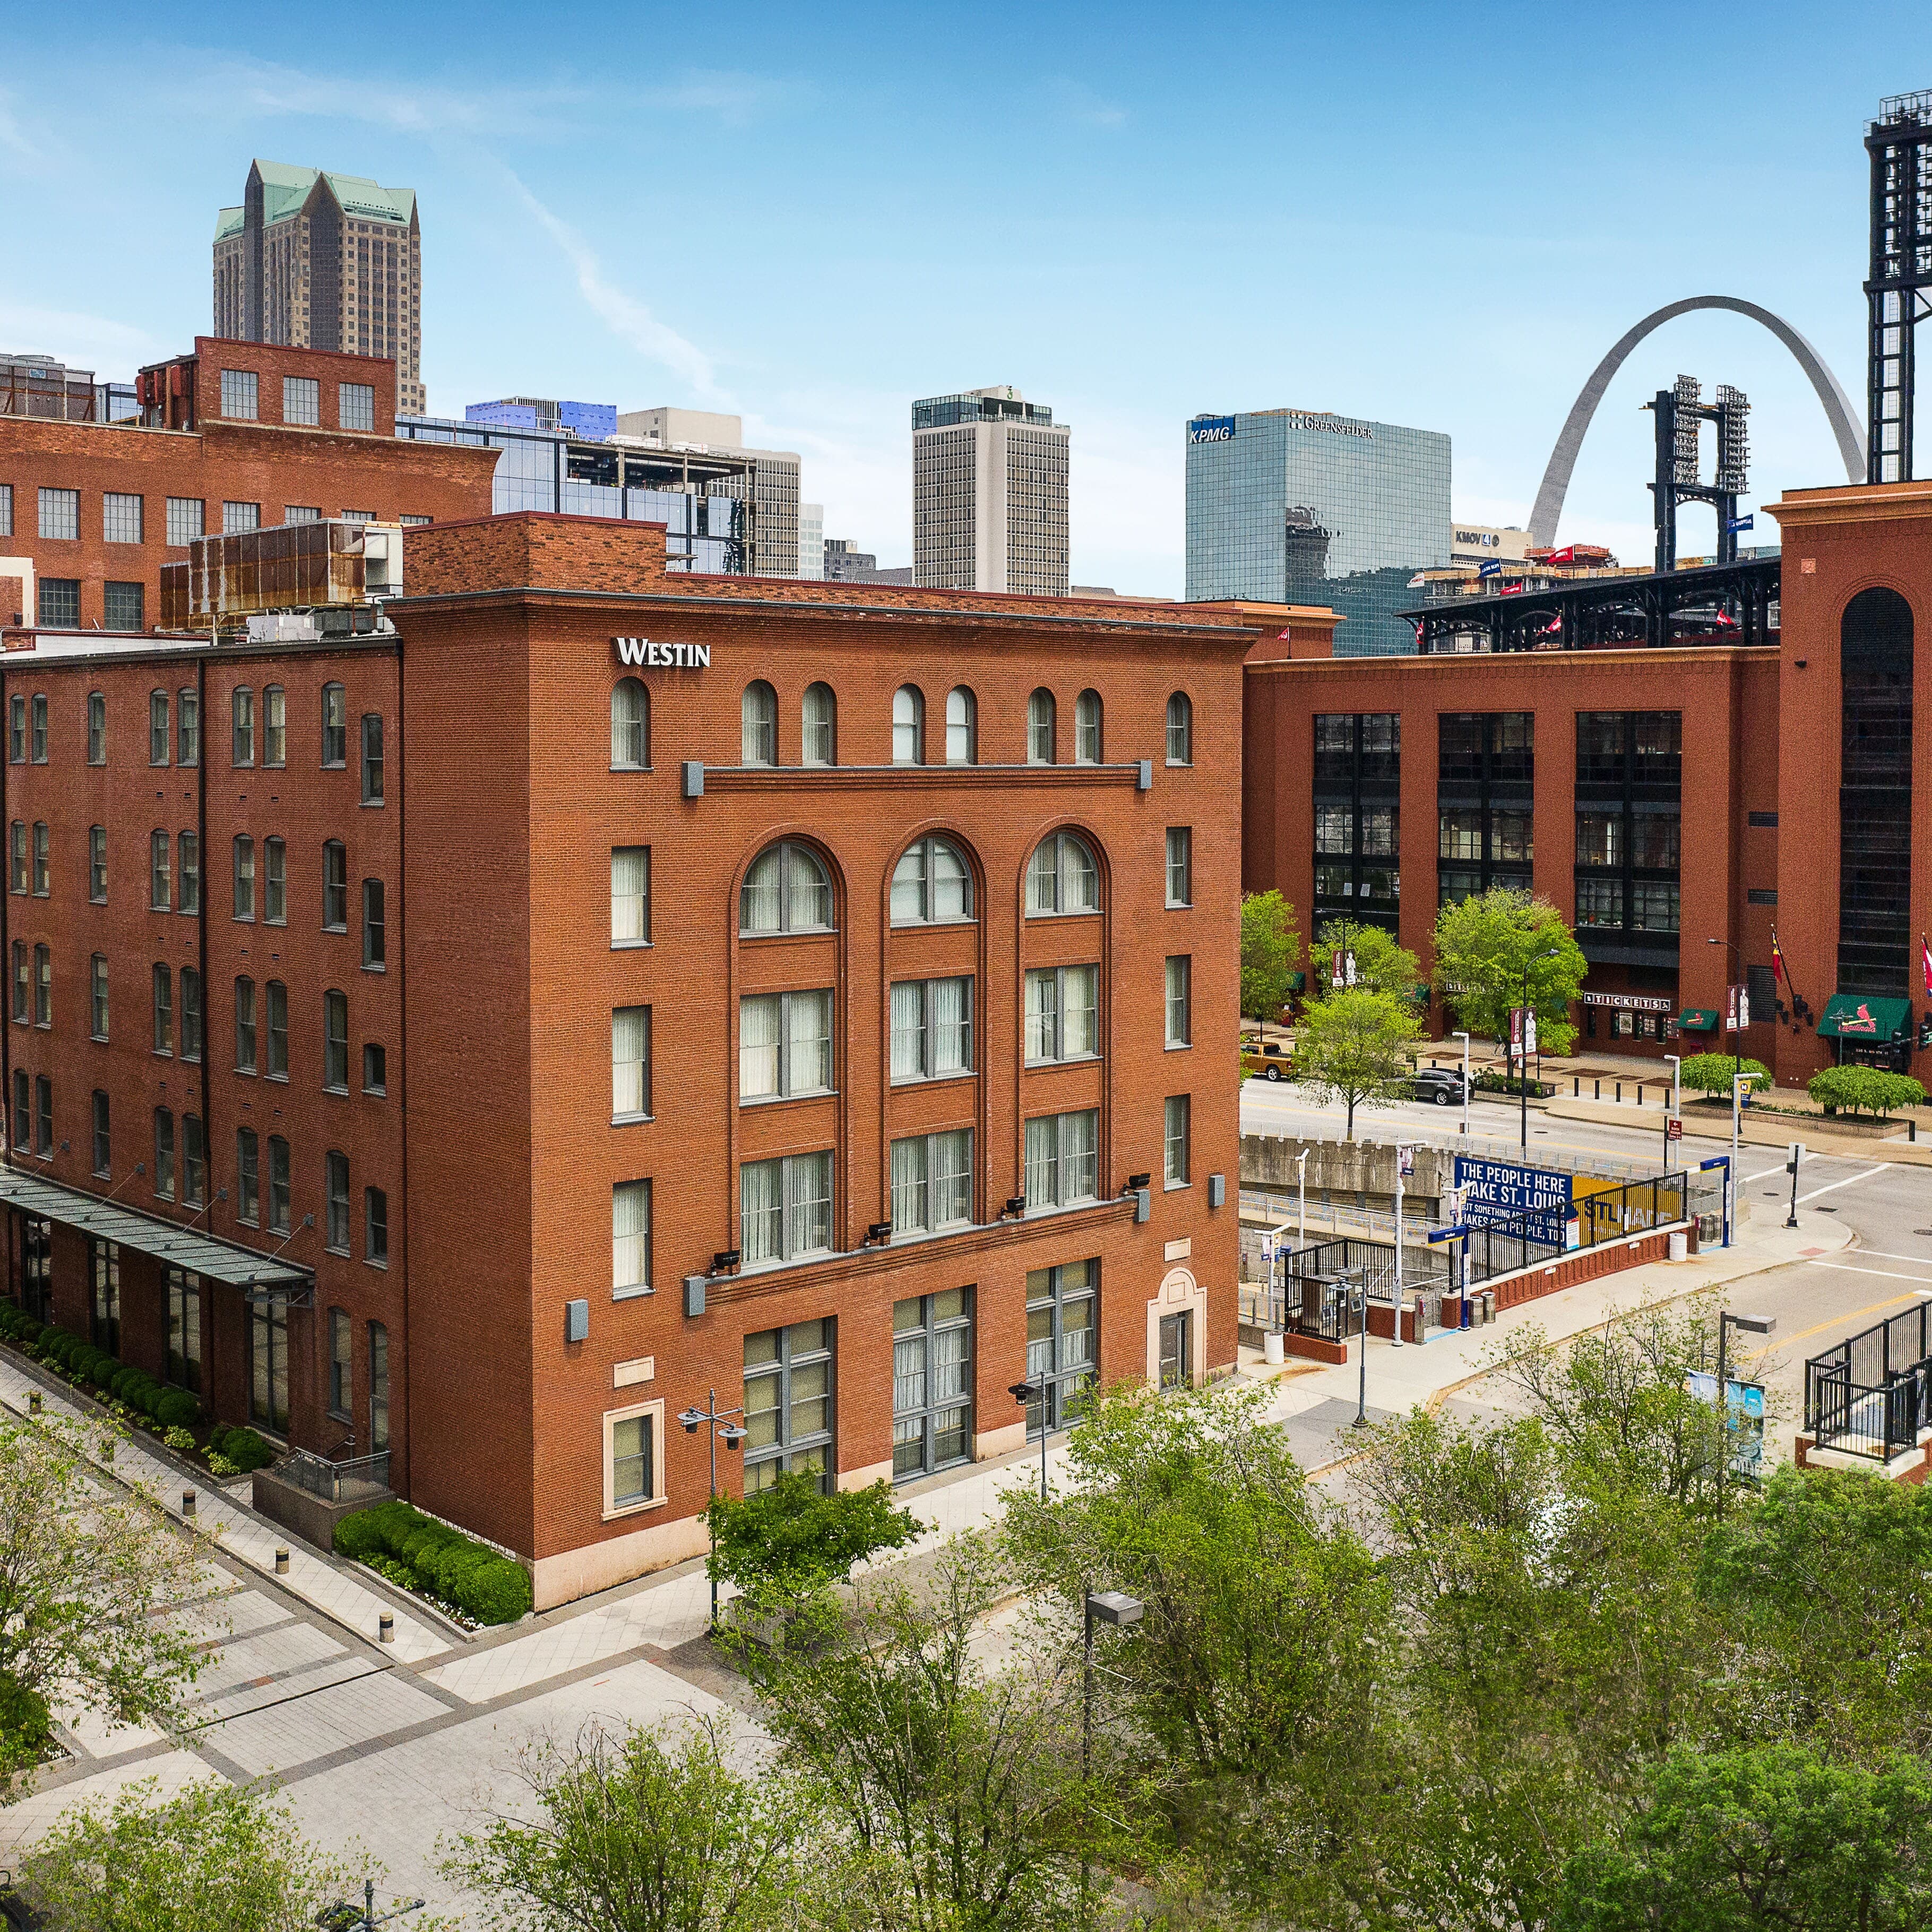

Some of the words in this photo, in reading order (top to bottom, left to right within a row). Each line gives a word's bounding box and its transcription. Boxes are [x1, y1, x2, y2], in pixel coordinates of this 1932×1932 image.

[1189, 427, 1230, 444] KPMG
[1305, 416, 1374, 438] GREENSFELDER
[1456, 531, 1481, 544] KMOV
[617, 637, 711, 667] WESTIN
[1595, 996, 1659, 1008] TICKETS
[1461, 1162, 1484, 1179] THE
[1487, 1166, 1531, 1188] PEOPLE
[1535, 1174, 1565, 1194] HERE
[1501, 1186, 1521, 1204] ST.
[1526, 1190, 1565, 1213] LOUIS
[1463, 1203, 1473, 1211] UT
[1474, 1204, 1510, 1218] SOMETHING
[1547, 1217, 1565, 1228] LOUS
